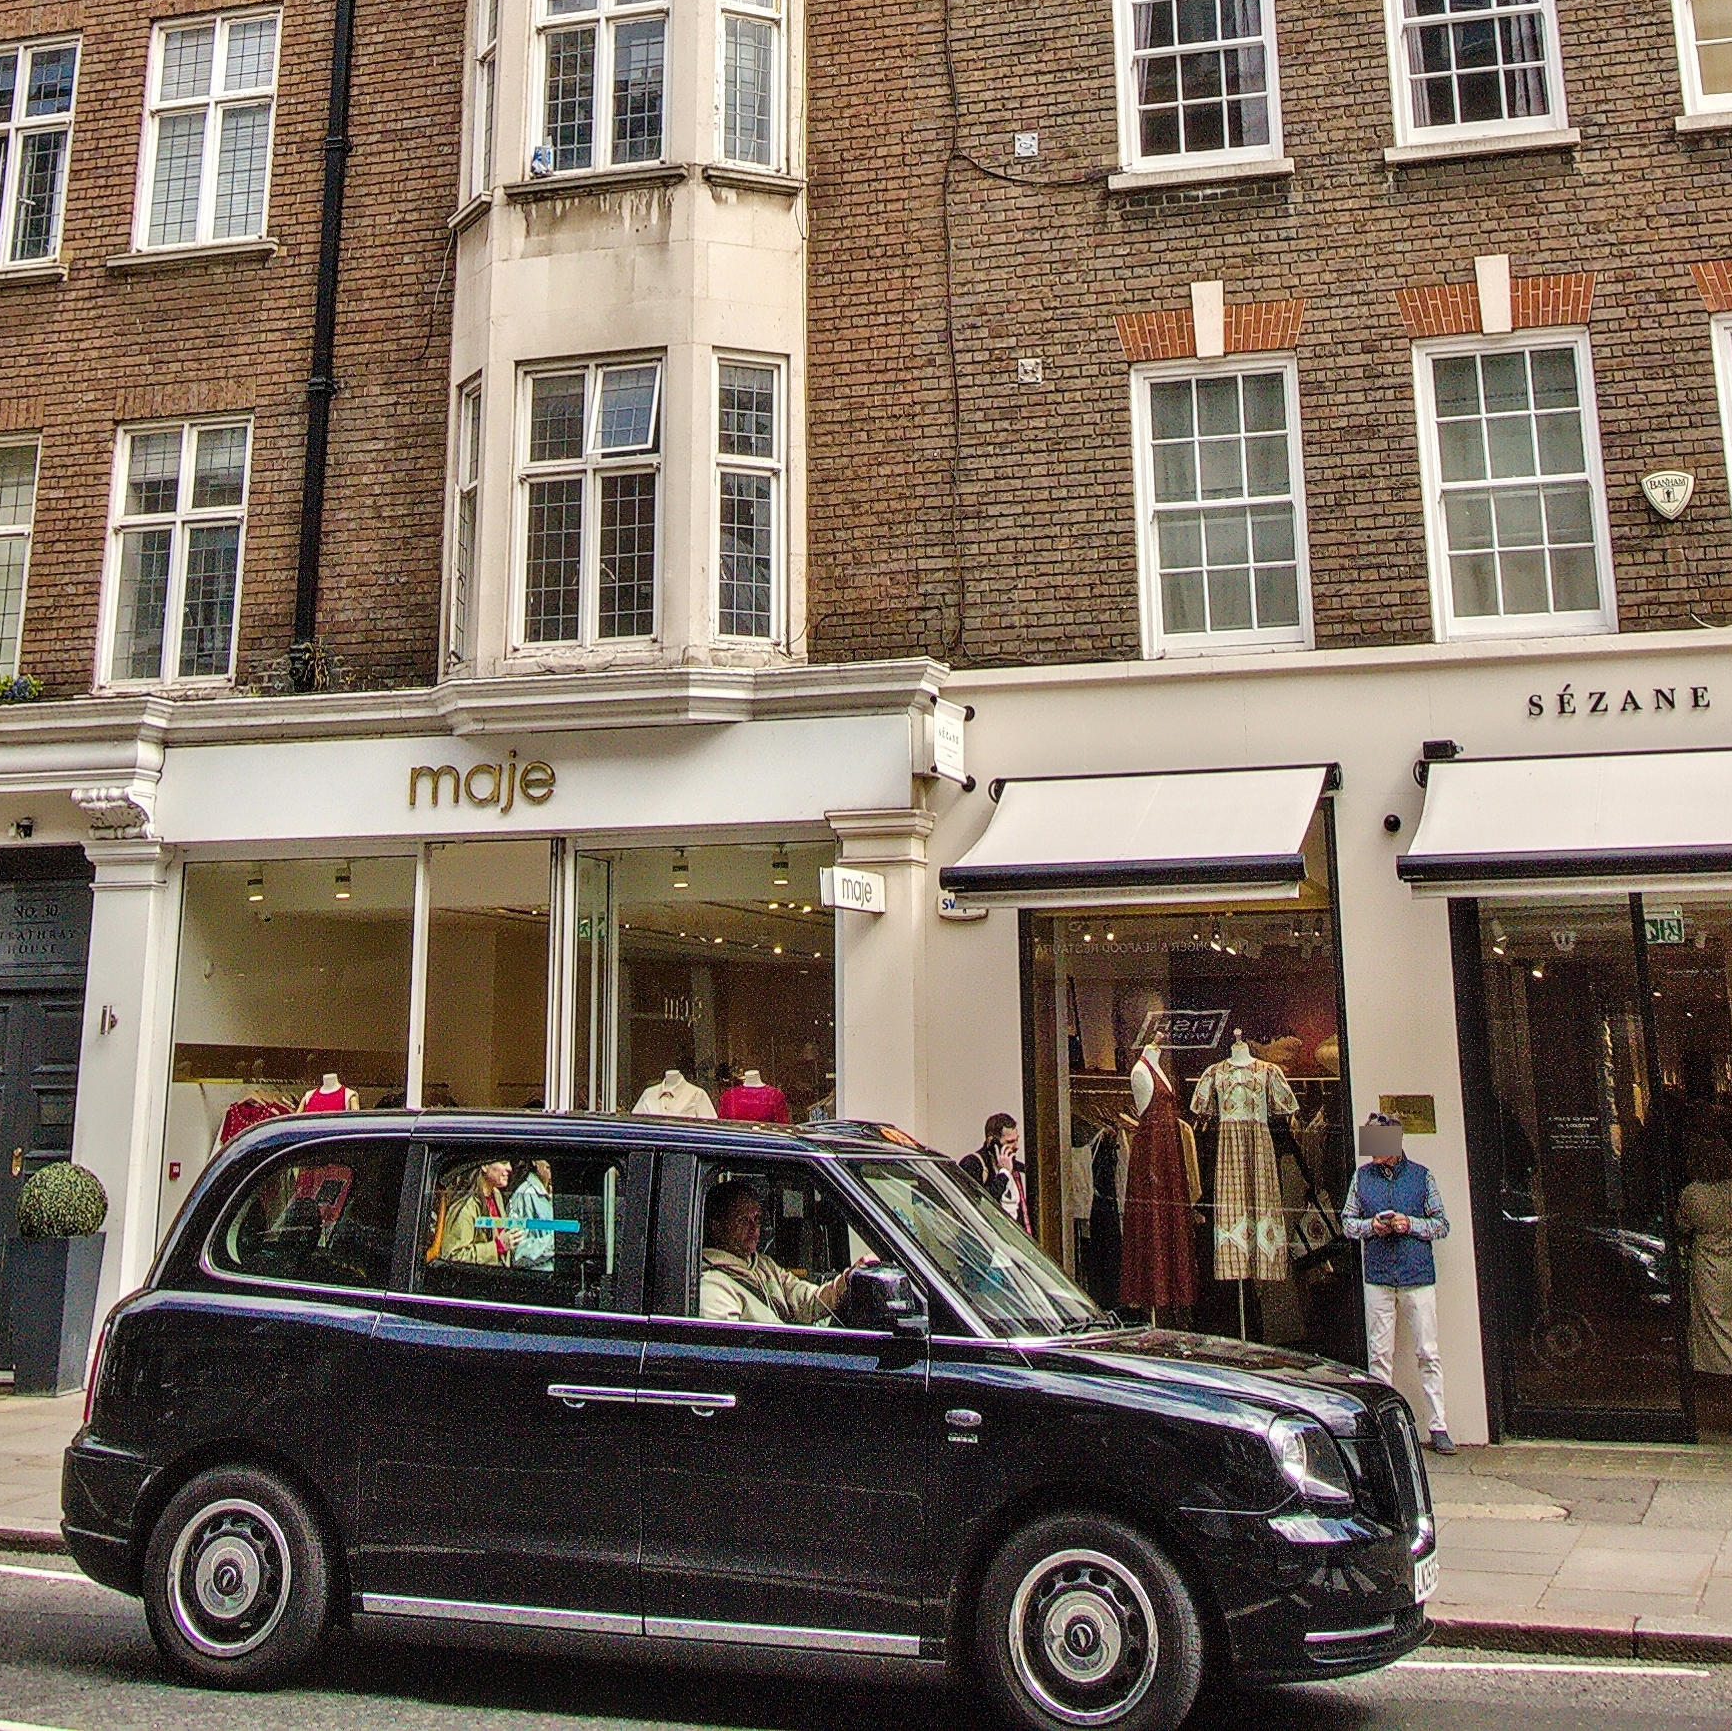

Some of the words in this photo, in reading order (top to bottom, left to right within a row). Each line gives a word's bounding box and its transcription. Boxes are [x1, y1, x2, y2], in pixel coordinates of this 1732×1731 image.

[1528, 684, 1711, 717] SÉZANE
[409, 749, 556, 814] maje
[841, 876, 873, 908] maje
